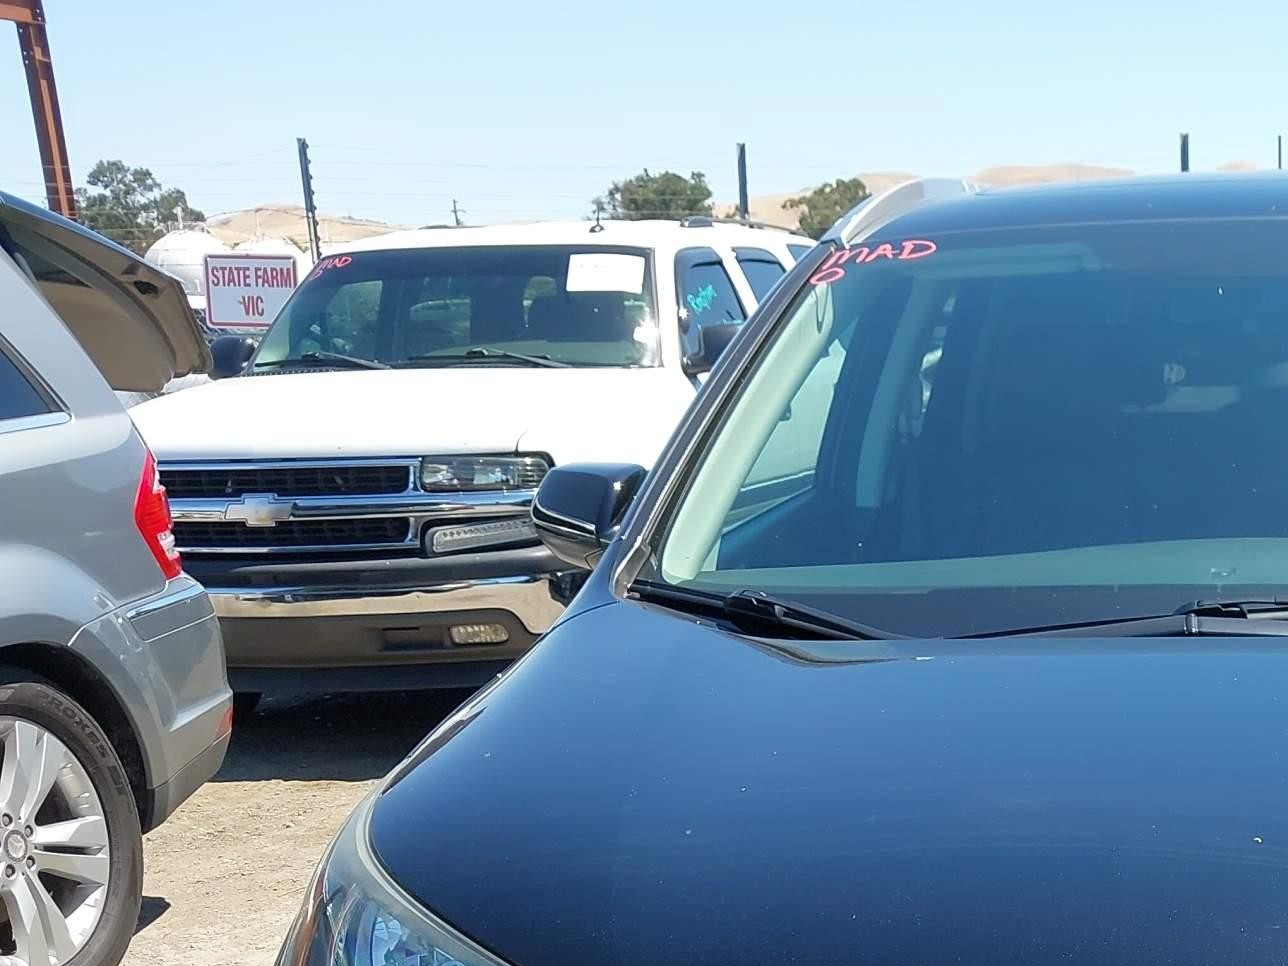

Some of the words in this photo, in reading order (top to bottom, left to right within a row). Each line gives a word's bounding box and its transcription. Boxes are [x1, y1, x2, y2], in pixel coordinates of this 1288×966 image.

[210, 266, 251, 288] STATE
[254, 267, 292, 289] FARM
[241, 295, 265, 317] VIC
